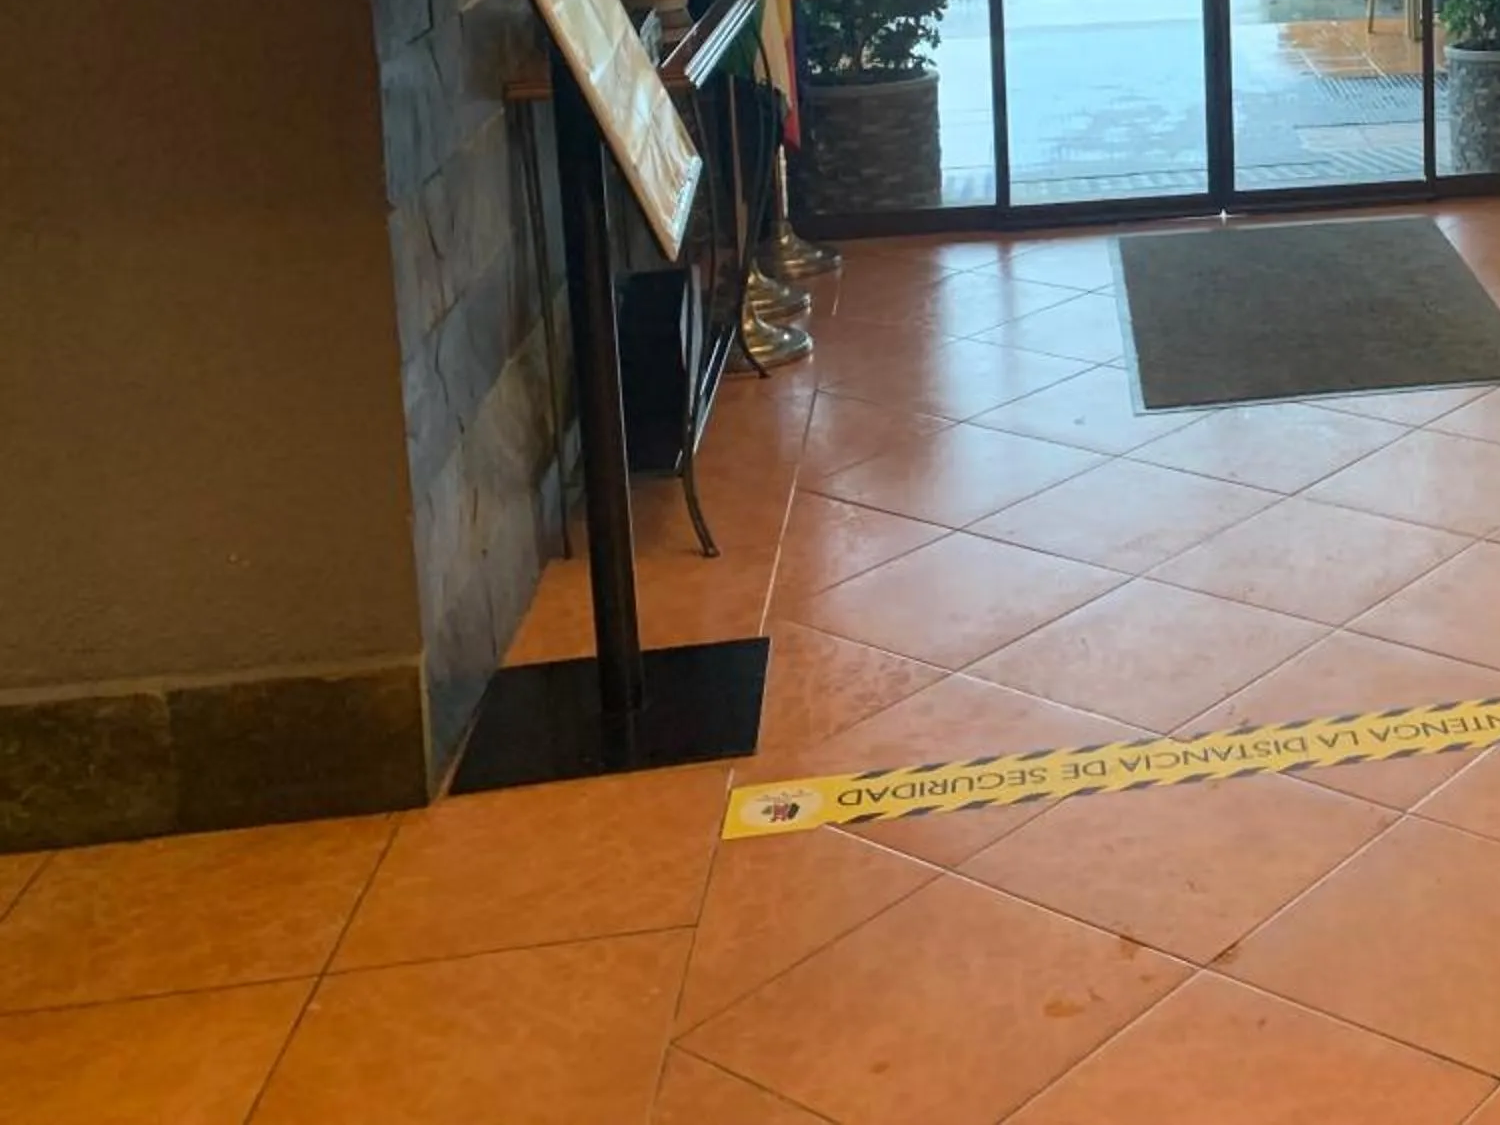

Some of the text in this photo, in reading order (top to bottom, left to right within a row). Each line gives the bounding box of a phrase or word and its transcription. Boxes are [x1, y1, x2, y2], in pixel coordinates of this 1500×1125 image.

[1317, 729, 1359, 748] LA
[1118, 736, 1307, 772] DISTANCIA
[1063, 759, 1107, 780] DE
[837, 767, 1047, 806] SEGURIDAD
